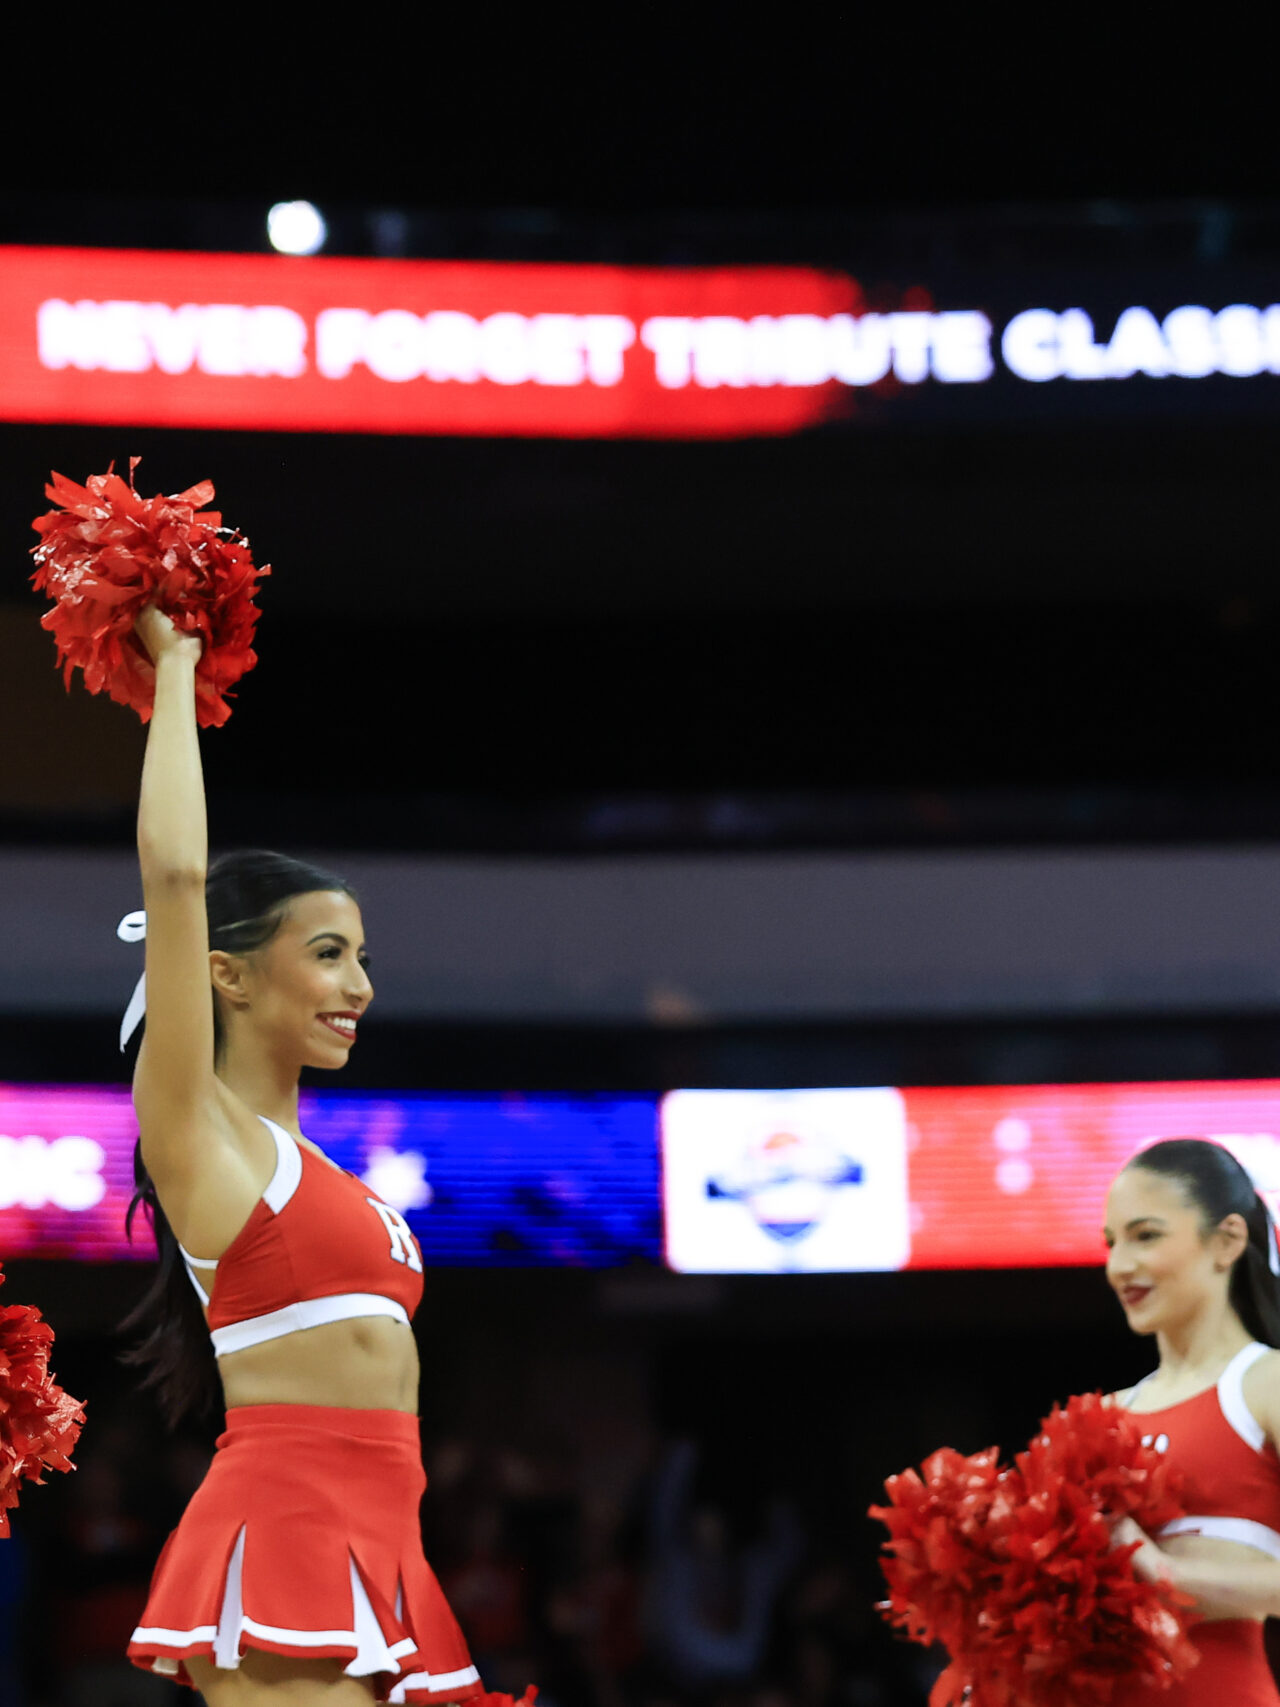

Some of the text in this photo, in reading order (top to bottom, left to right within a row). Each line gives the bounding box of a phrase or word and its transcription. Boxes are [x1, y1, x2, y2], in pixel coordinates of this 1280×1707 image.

[37, 298, 307, 378] NEVER
[316, 308, 634, 387] FORGET
[640, 310, 994, 388] TRIBUTE
[365, 1196, 423, 1274] R
